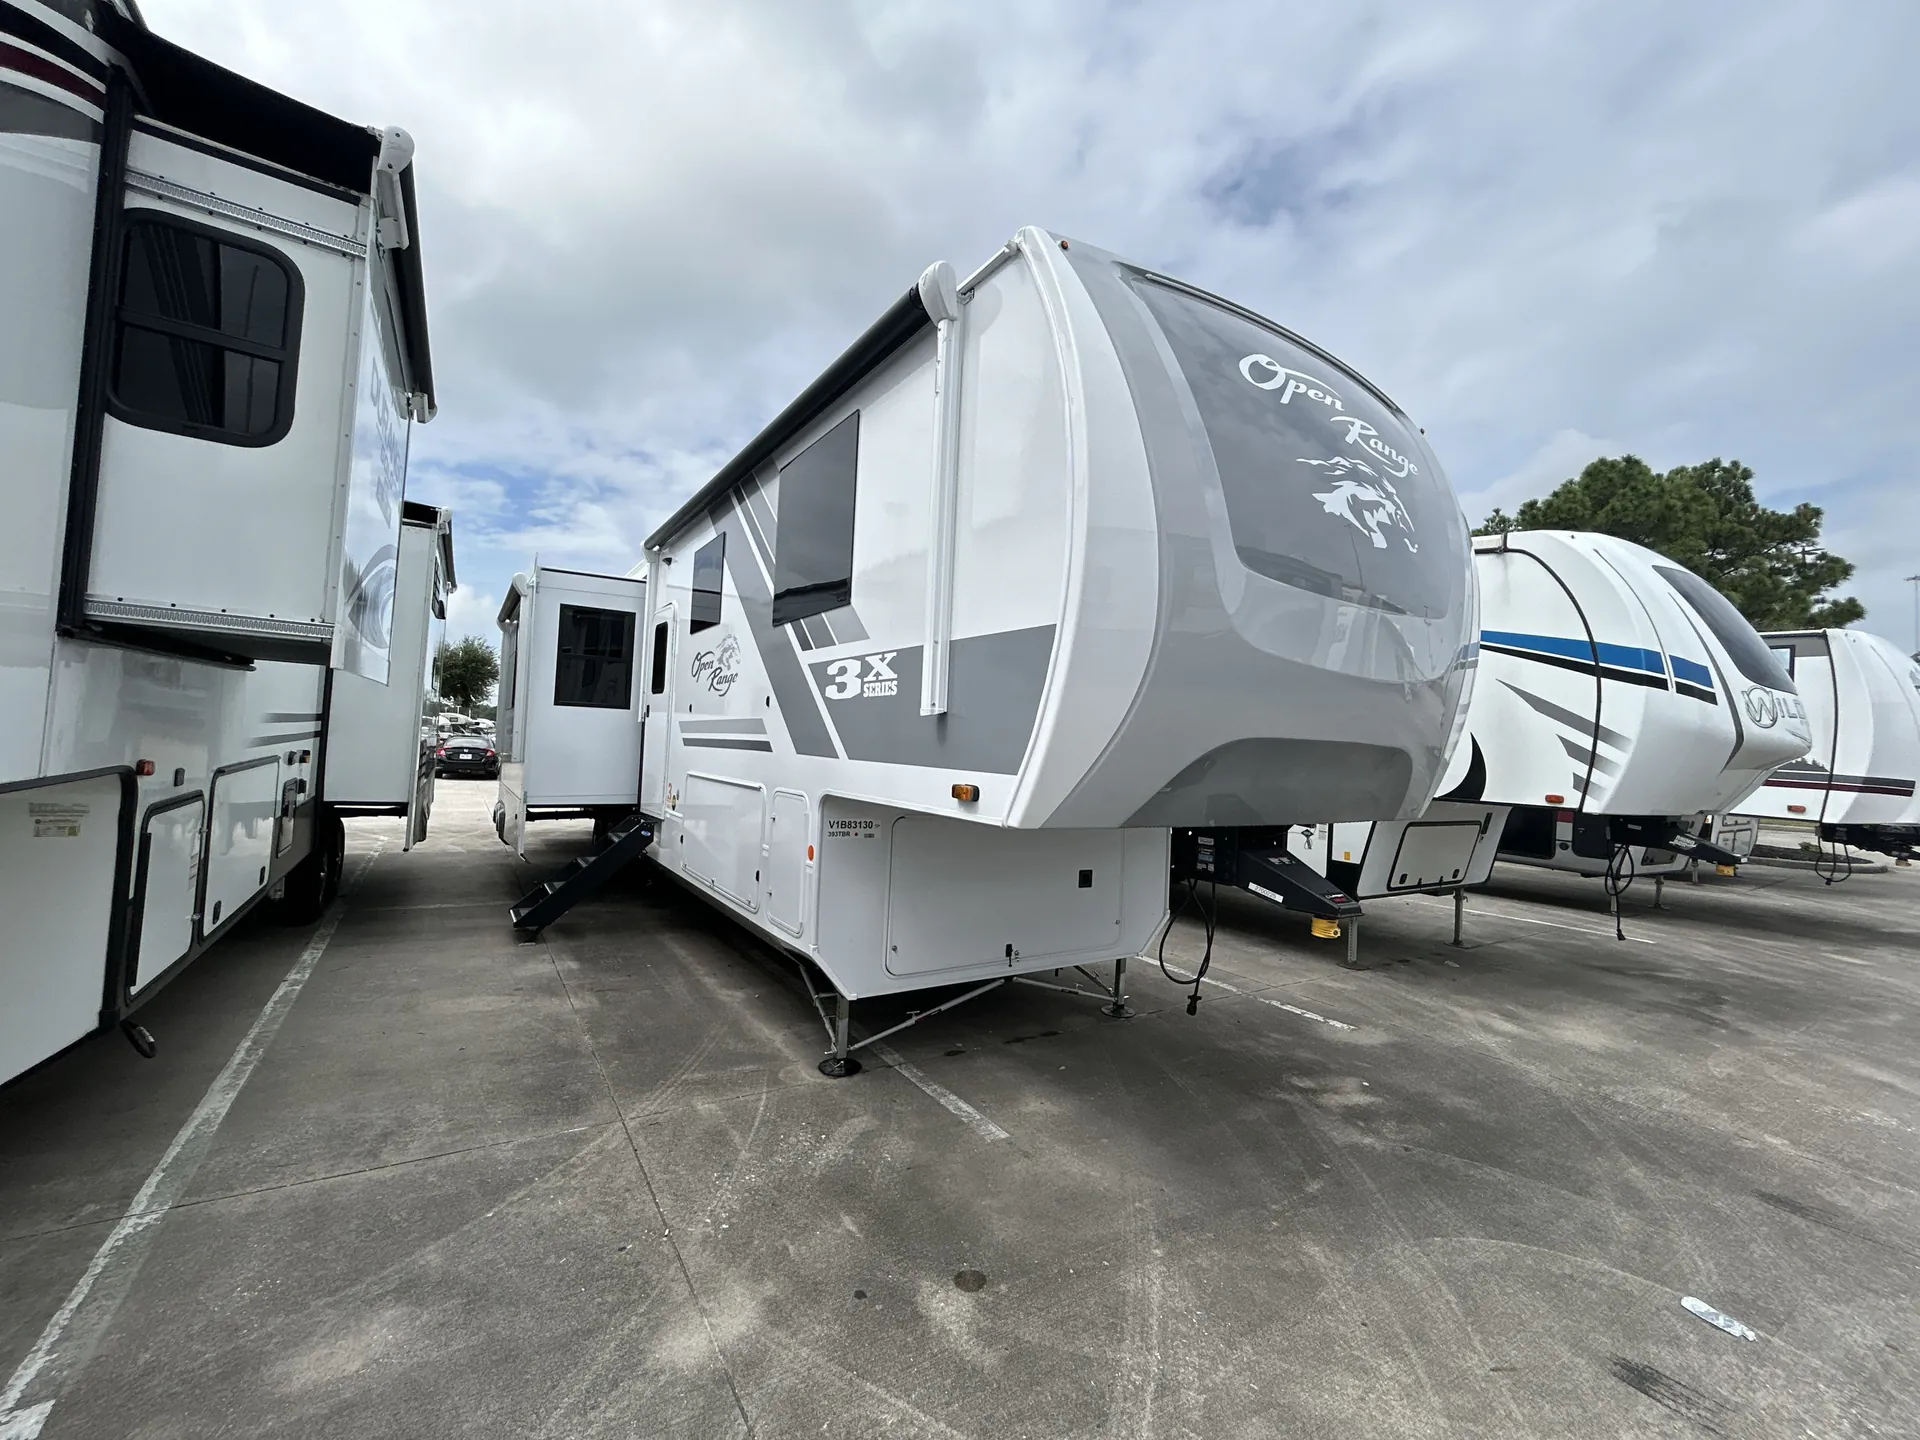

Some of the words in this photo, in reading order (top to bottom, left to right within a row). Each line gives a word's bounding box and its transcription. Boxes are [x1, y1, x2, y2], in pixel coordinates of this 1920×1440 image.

[1239, 354, 1345, 411] Open
[1330, 416, 1418, 477] Range
[691, 651, 715, 682] Open
[706, 666, 738, 697] Range
[863, 681, 898, 698] SERIES
[828, 820, 874, 829] V1B83130
